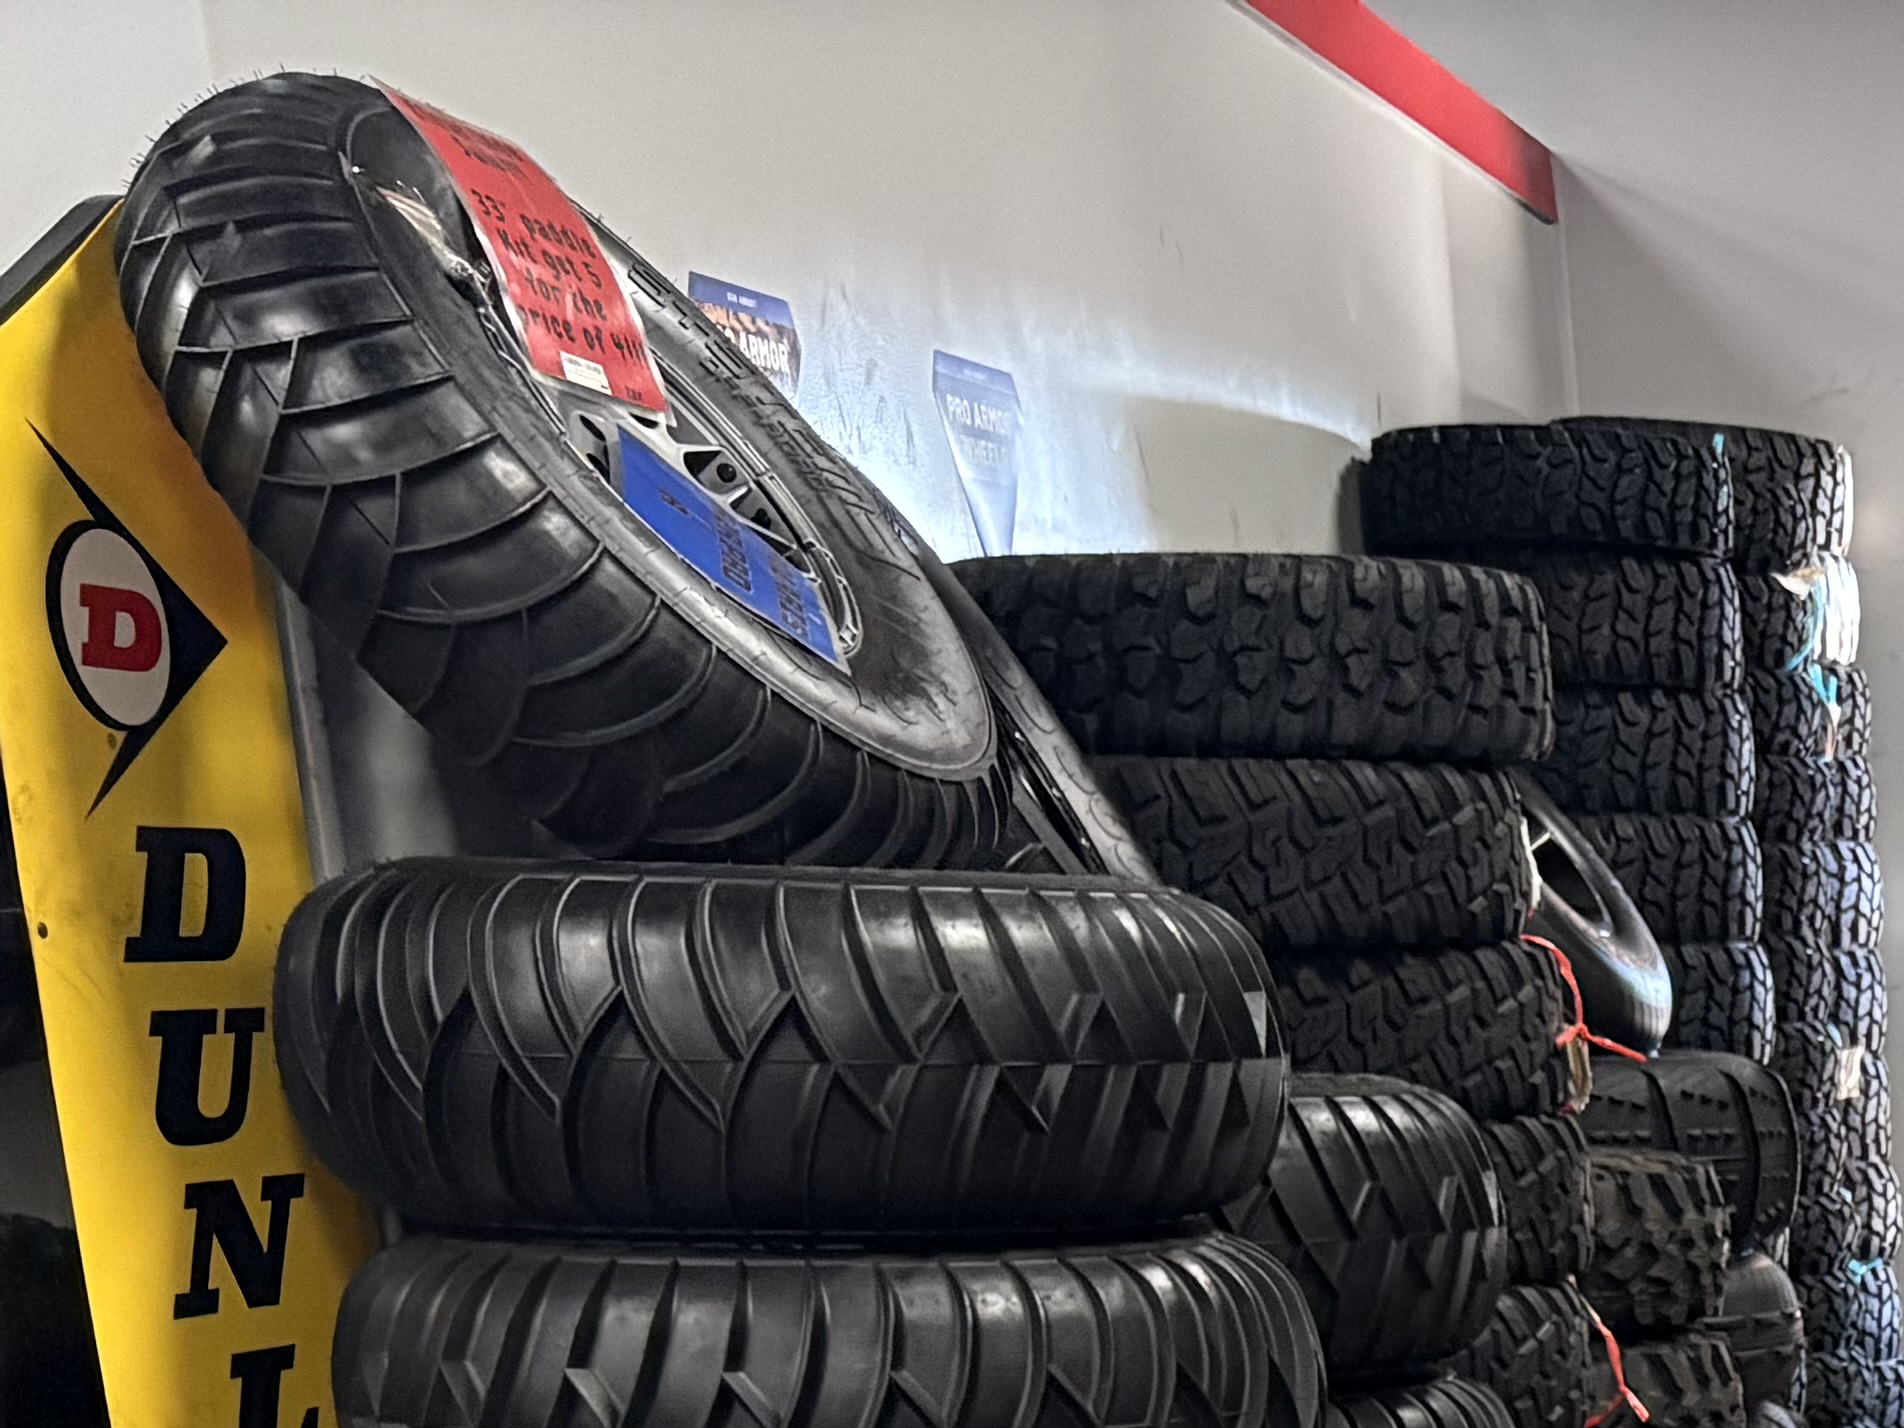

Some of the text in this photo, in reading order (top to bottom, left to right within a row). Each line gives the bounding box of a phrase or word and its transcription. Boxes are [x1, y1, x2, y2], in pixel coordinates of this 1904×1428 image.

[520, 213, 596, 258] paddle
[542, 249, 582, 282] get
[570, 285, 608, 321] the
[583, 325, 605, 355] of
[974, 402, 1010, 436] ARM
[80, 586, 164, 672] D
